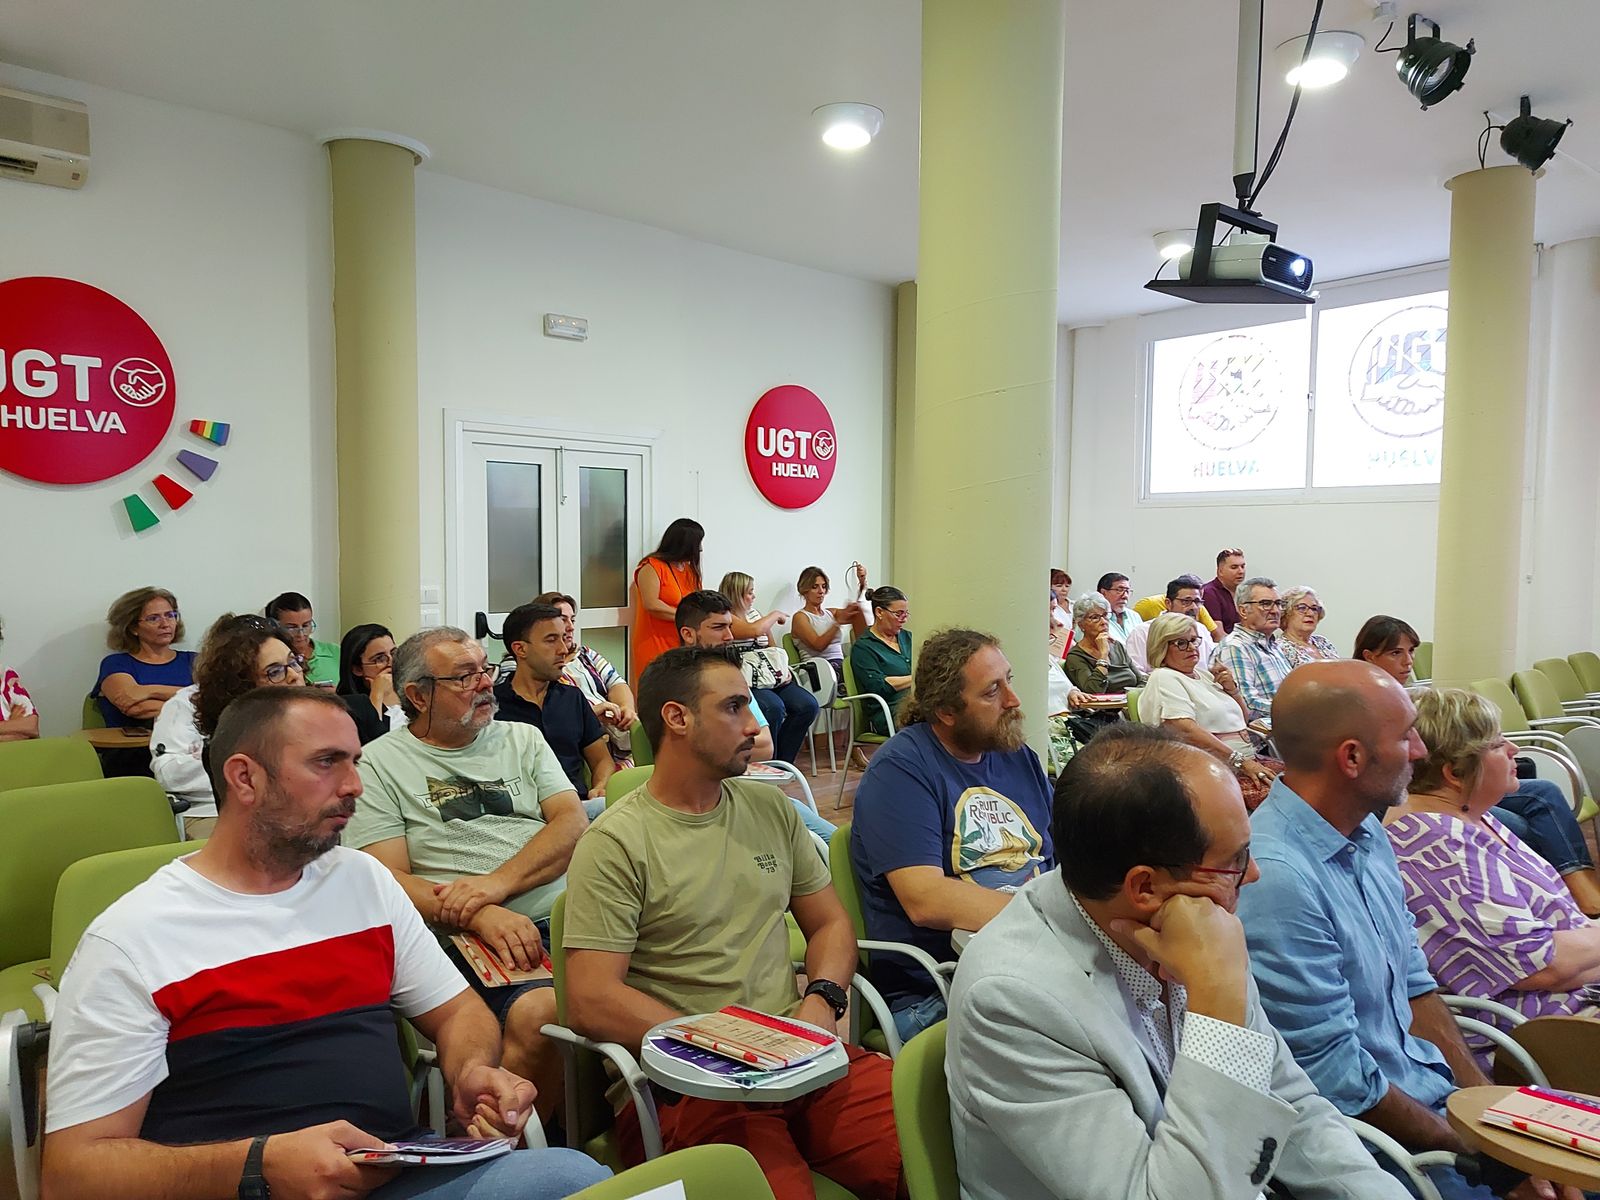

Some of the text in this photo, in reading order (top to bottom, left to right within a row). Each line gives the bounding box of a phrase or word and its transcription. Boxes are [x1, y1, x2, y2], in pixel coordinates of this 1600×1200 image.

[0, 348, 102, 402] GT
[0, 404, 127, 434] HUELVA
[757, 426, 812, 459] UGT
[772, 462, 819, 479] HUELVA
[977, 800, 998, 811] RUIT
